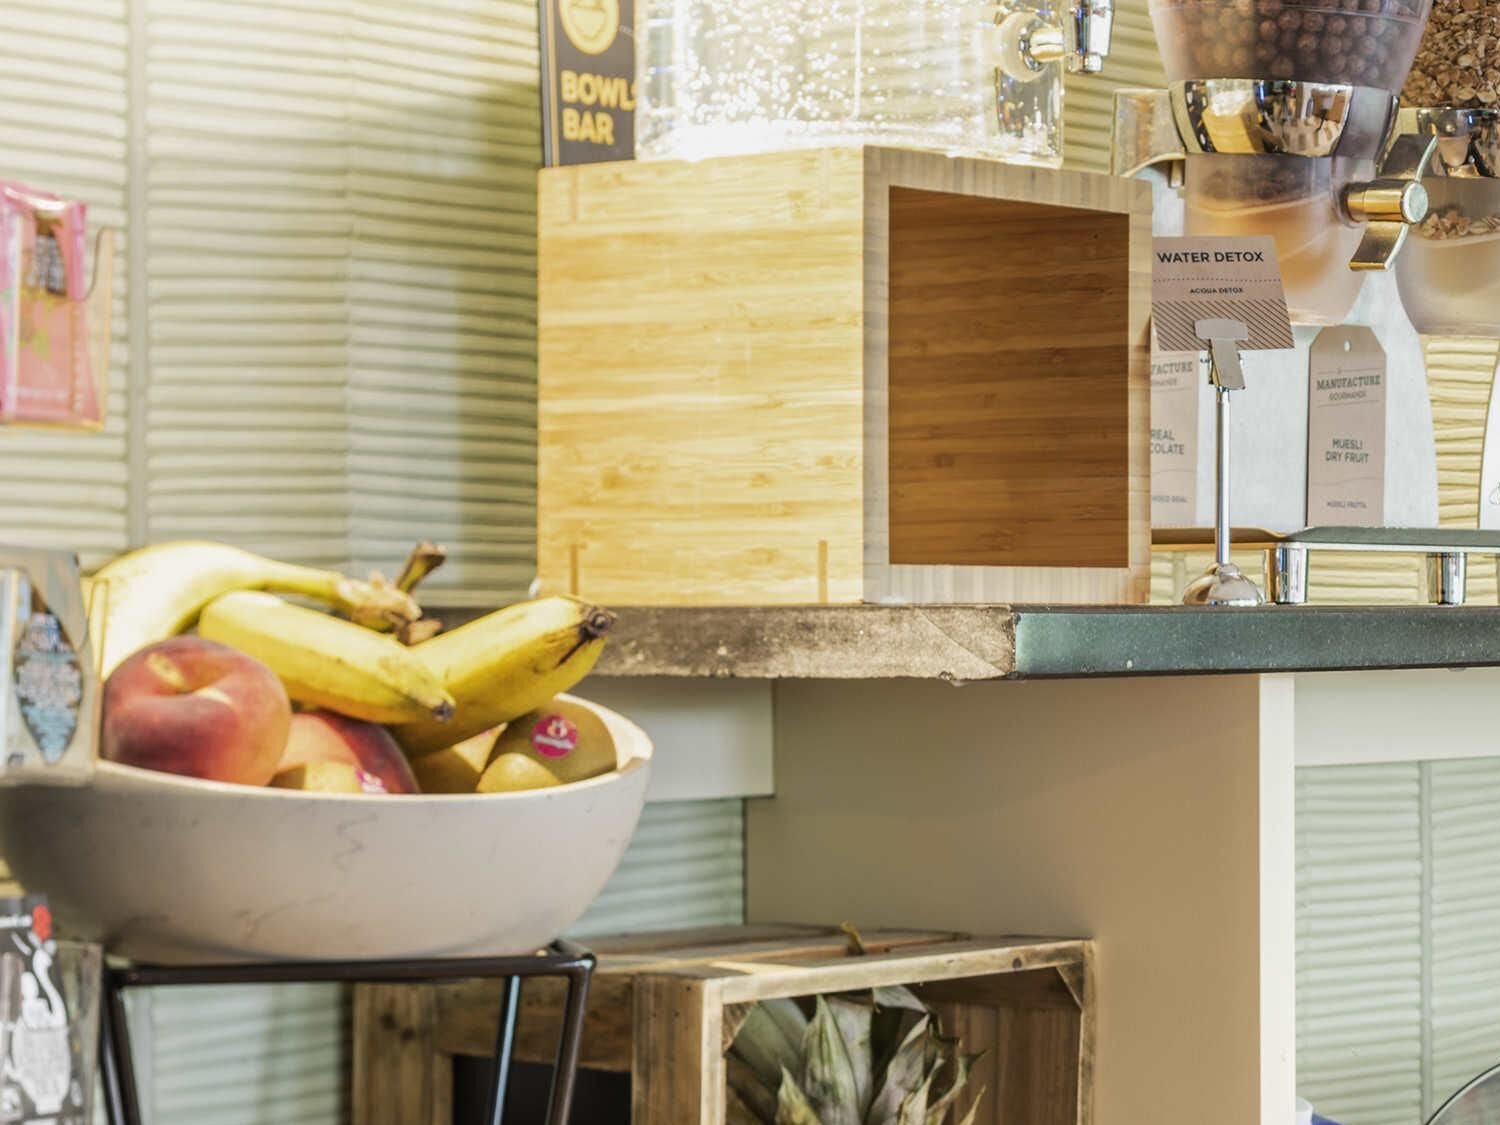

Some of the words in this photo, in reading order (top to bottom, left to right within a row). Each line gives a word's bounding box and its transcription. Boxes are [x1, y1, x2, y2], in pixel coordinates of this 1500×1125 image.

[562, 107, 615, 145] BAR
[1157, 251, 1210, 263] WATER
[1214, 251, 1264, 263] DETOX
[1316, 375, 1381, 390] MANUFACTURE
[1332, 438, 1363, 450] MUESLI
[1326, 451, 1342, 462] DRY
[1344, 452, 1369, 464] FRUIT
